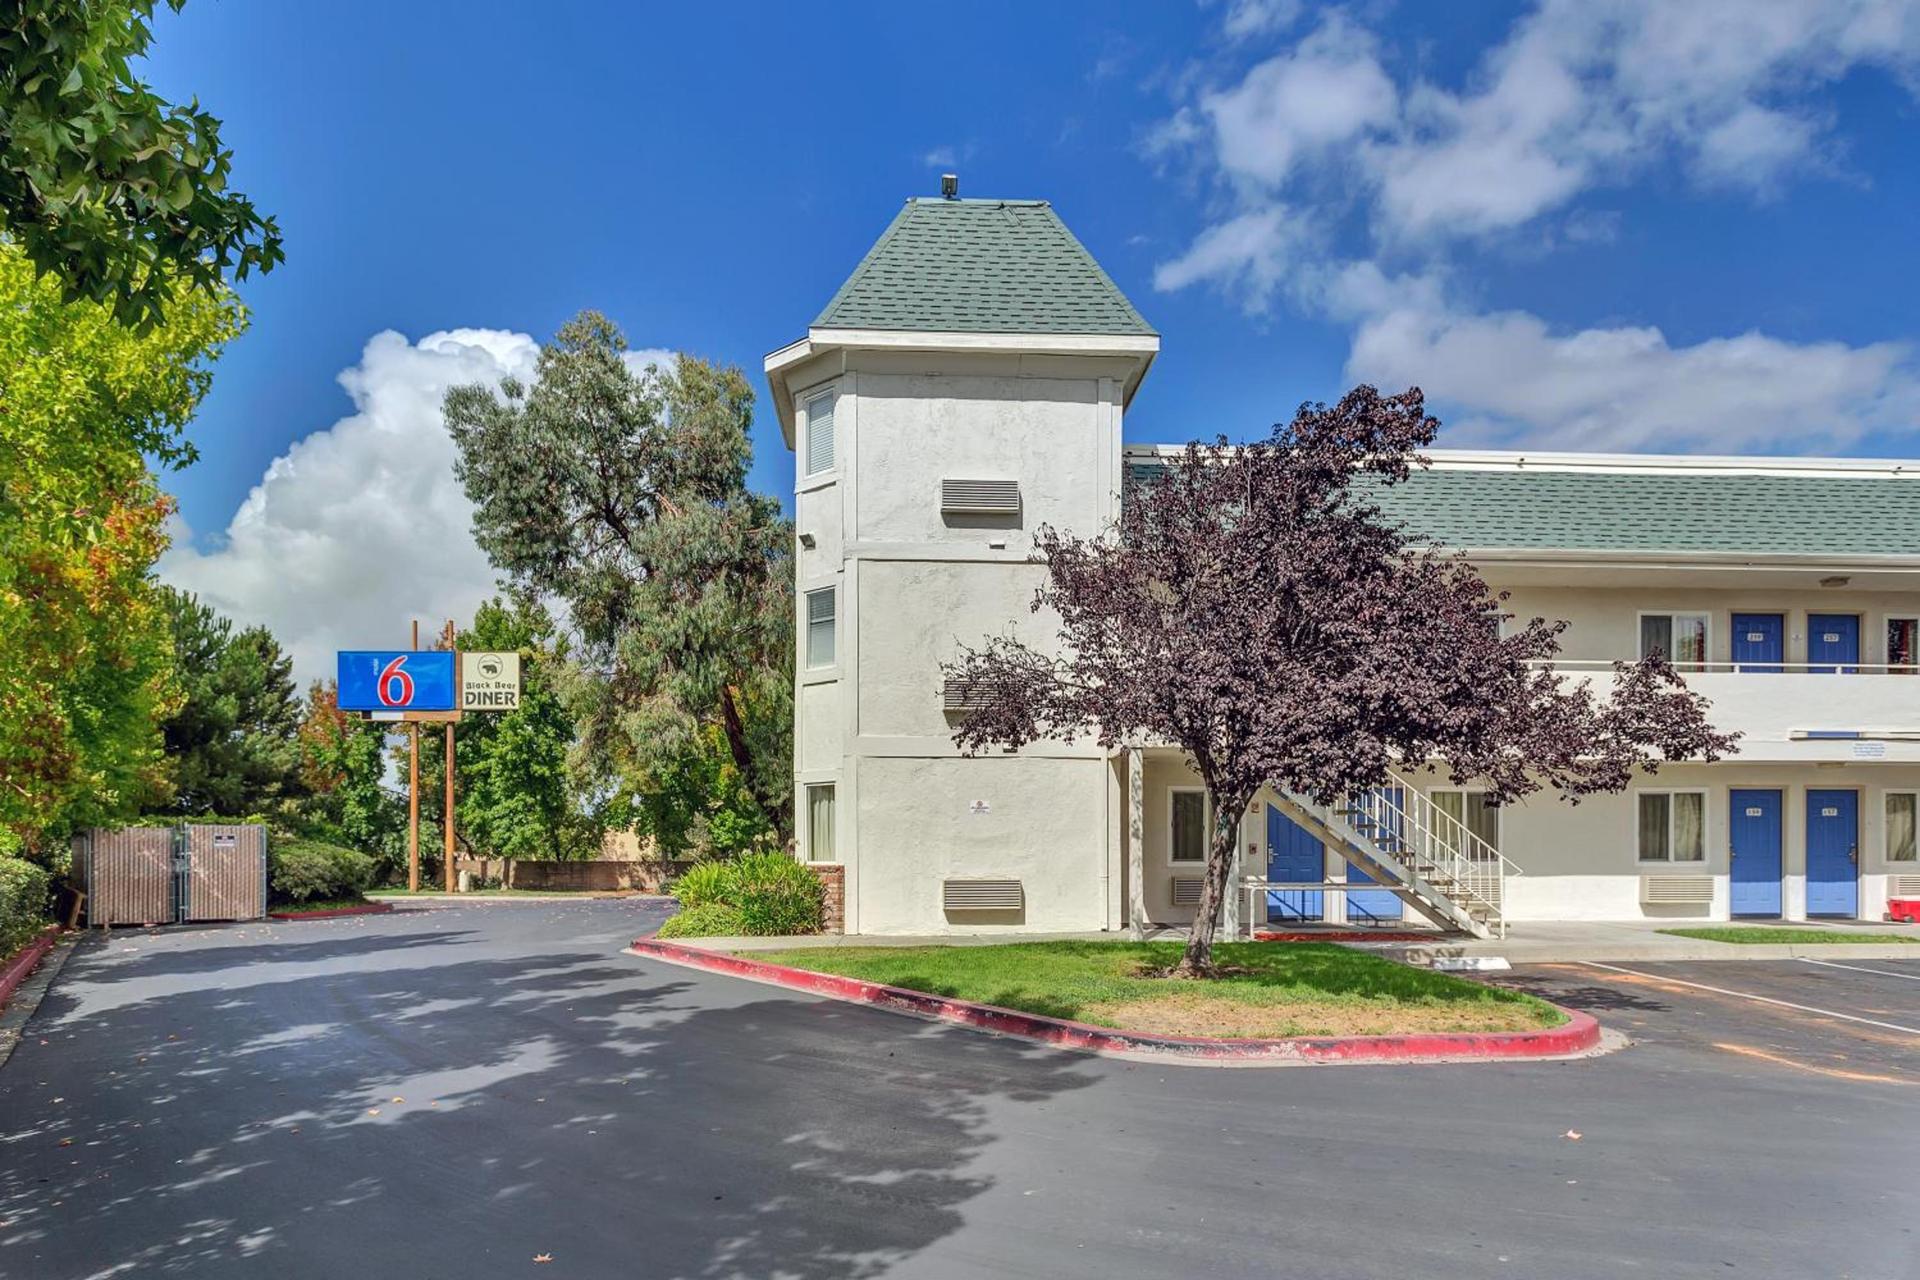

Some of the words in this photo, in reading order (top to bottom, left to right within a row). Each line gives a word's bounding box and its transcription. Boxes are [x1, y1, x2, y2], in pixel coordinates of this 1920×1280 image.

[377, 655, 415, 706] 6
[466, 682, 490, 690] Black
[465, 691, 516, 706] DINER
